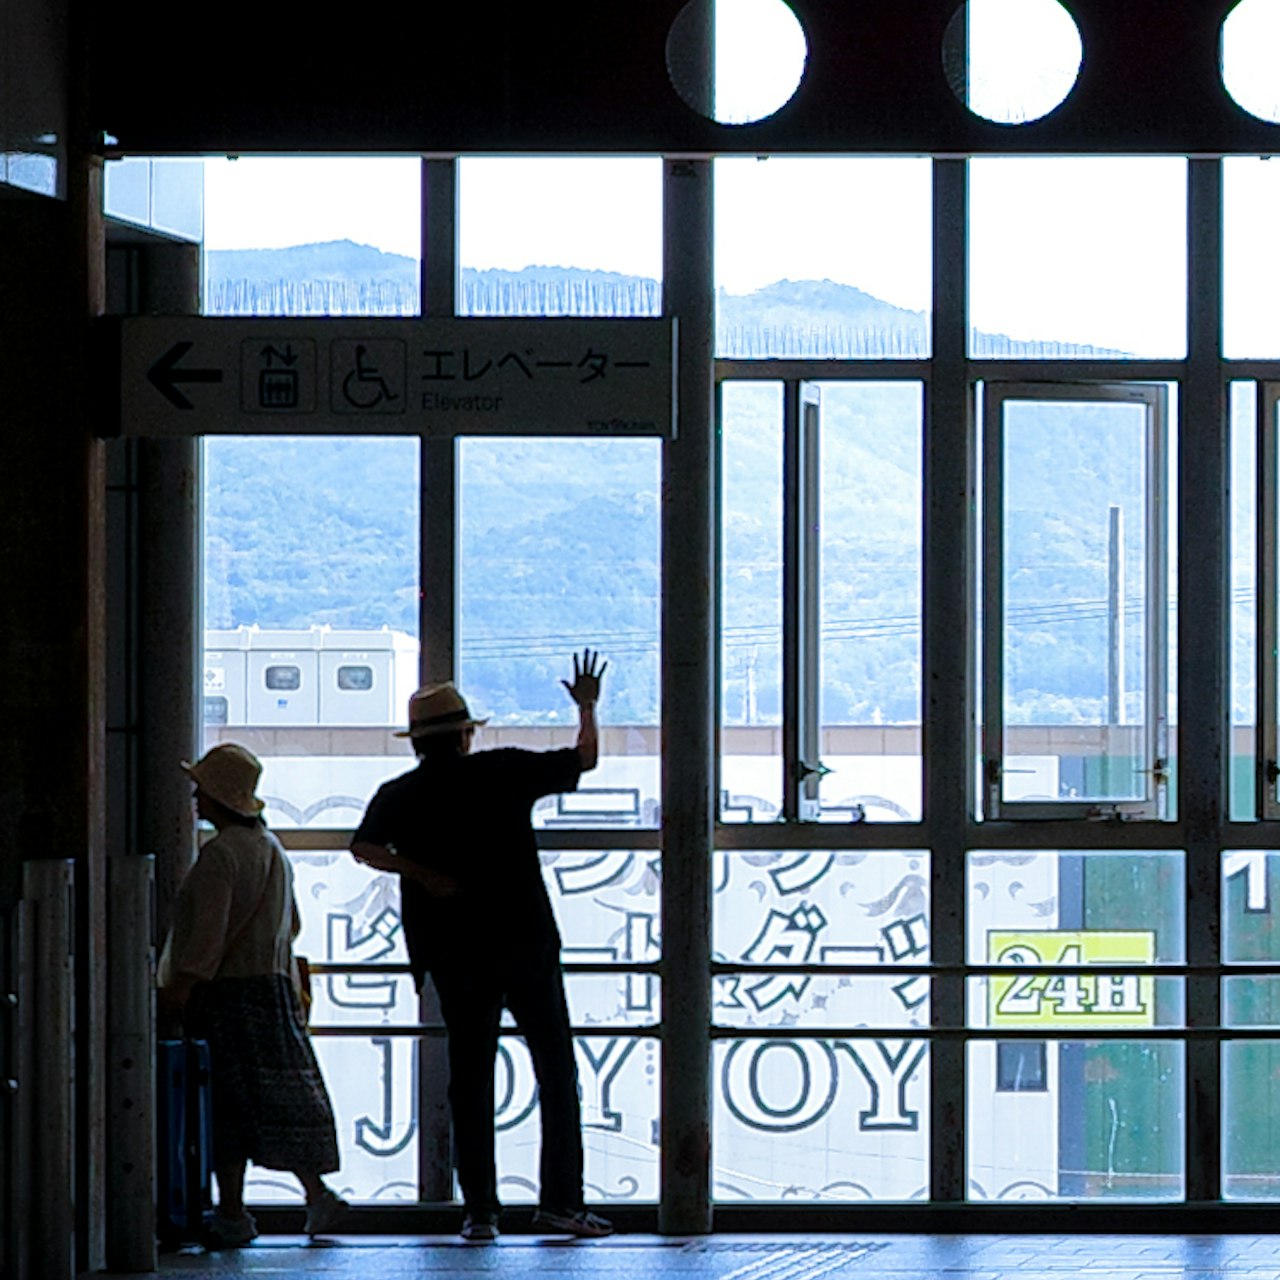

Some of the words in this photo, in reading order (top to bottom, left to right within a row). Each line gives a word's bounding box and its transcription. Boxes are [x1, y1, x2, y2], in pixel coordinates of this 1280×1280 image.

[421, 347, 651, 384] エレベーター
[421, 392, 503, 412] Elevator
[995, 944, 1147, 1016] 24H
